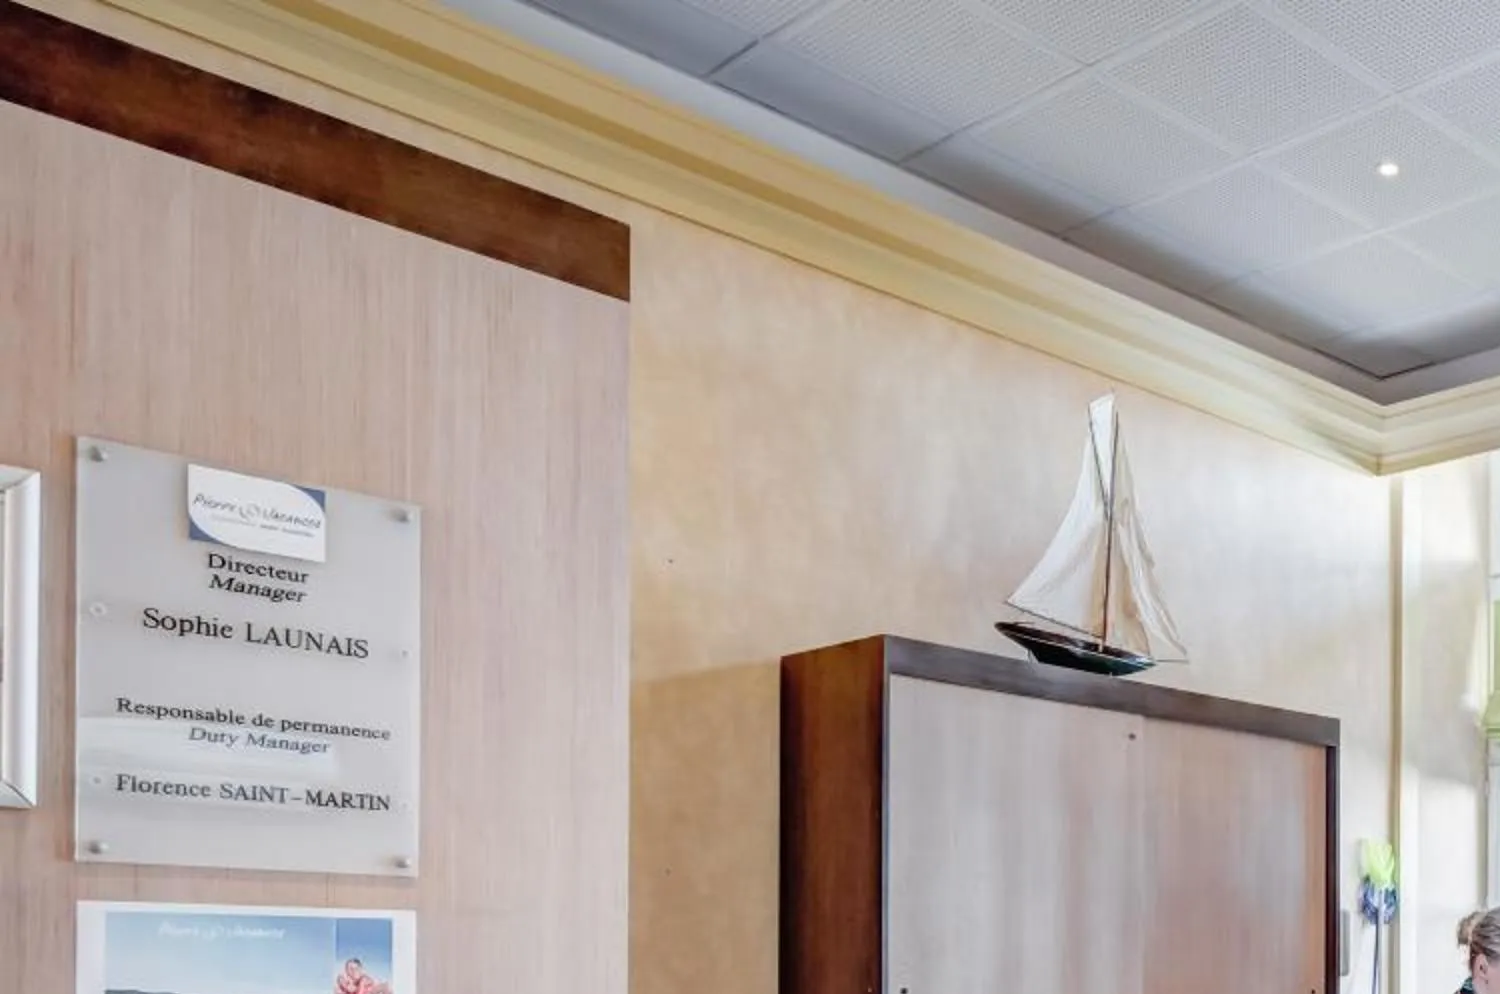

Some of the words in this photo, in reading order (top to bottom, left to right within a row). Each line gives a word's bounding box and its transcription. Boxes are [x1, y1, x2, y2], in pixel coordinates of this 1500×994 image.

[207, 553, 310, 583] Directeur
[209, 574, 308, 603] Manager
[142, 607, 234, 640] Sophie
[245, 621, 370, 659] LAUNAIS
[115, 697, 246, 726] Responsable
[251, 711, 275, 728] de
[280, 717, 391, 741] permanence
[188, 727, 239, 747] Duty
[246, 732, 332, 755] Manager
[115, 773, 211, 799] Florence
